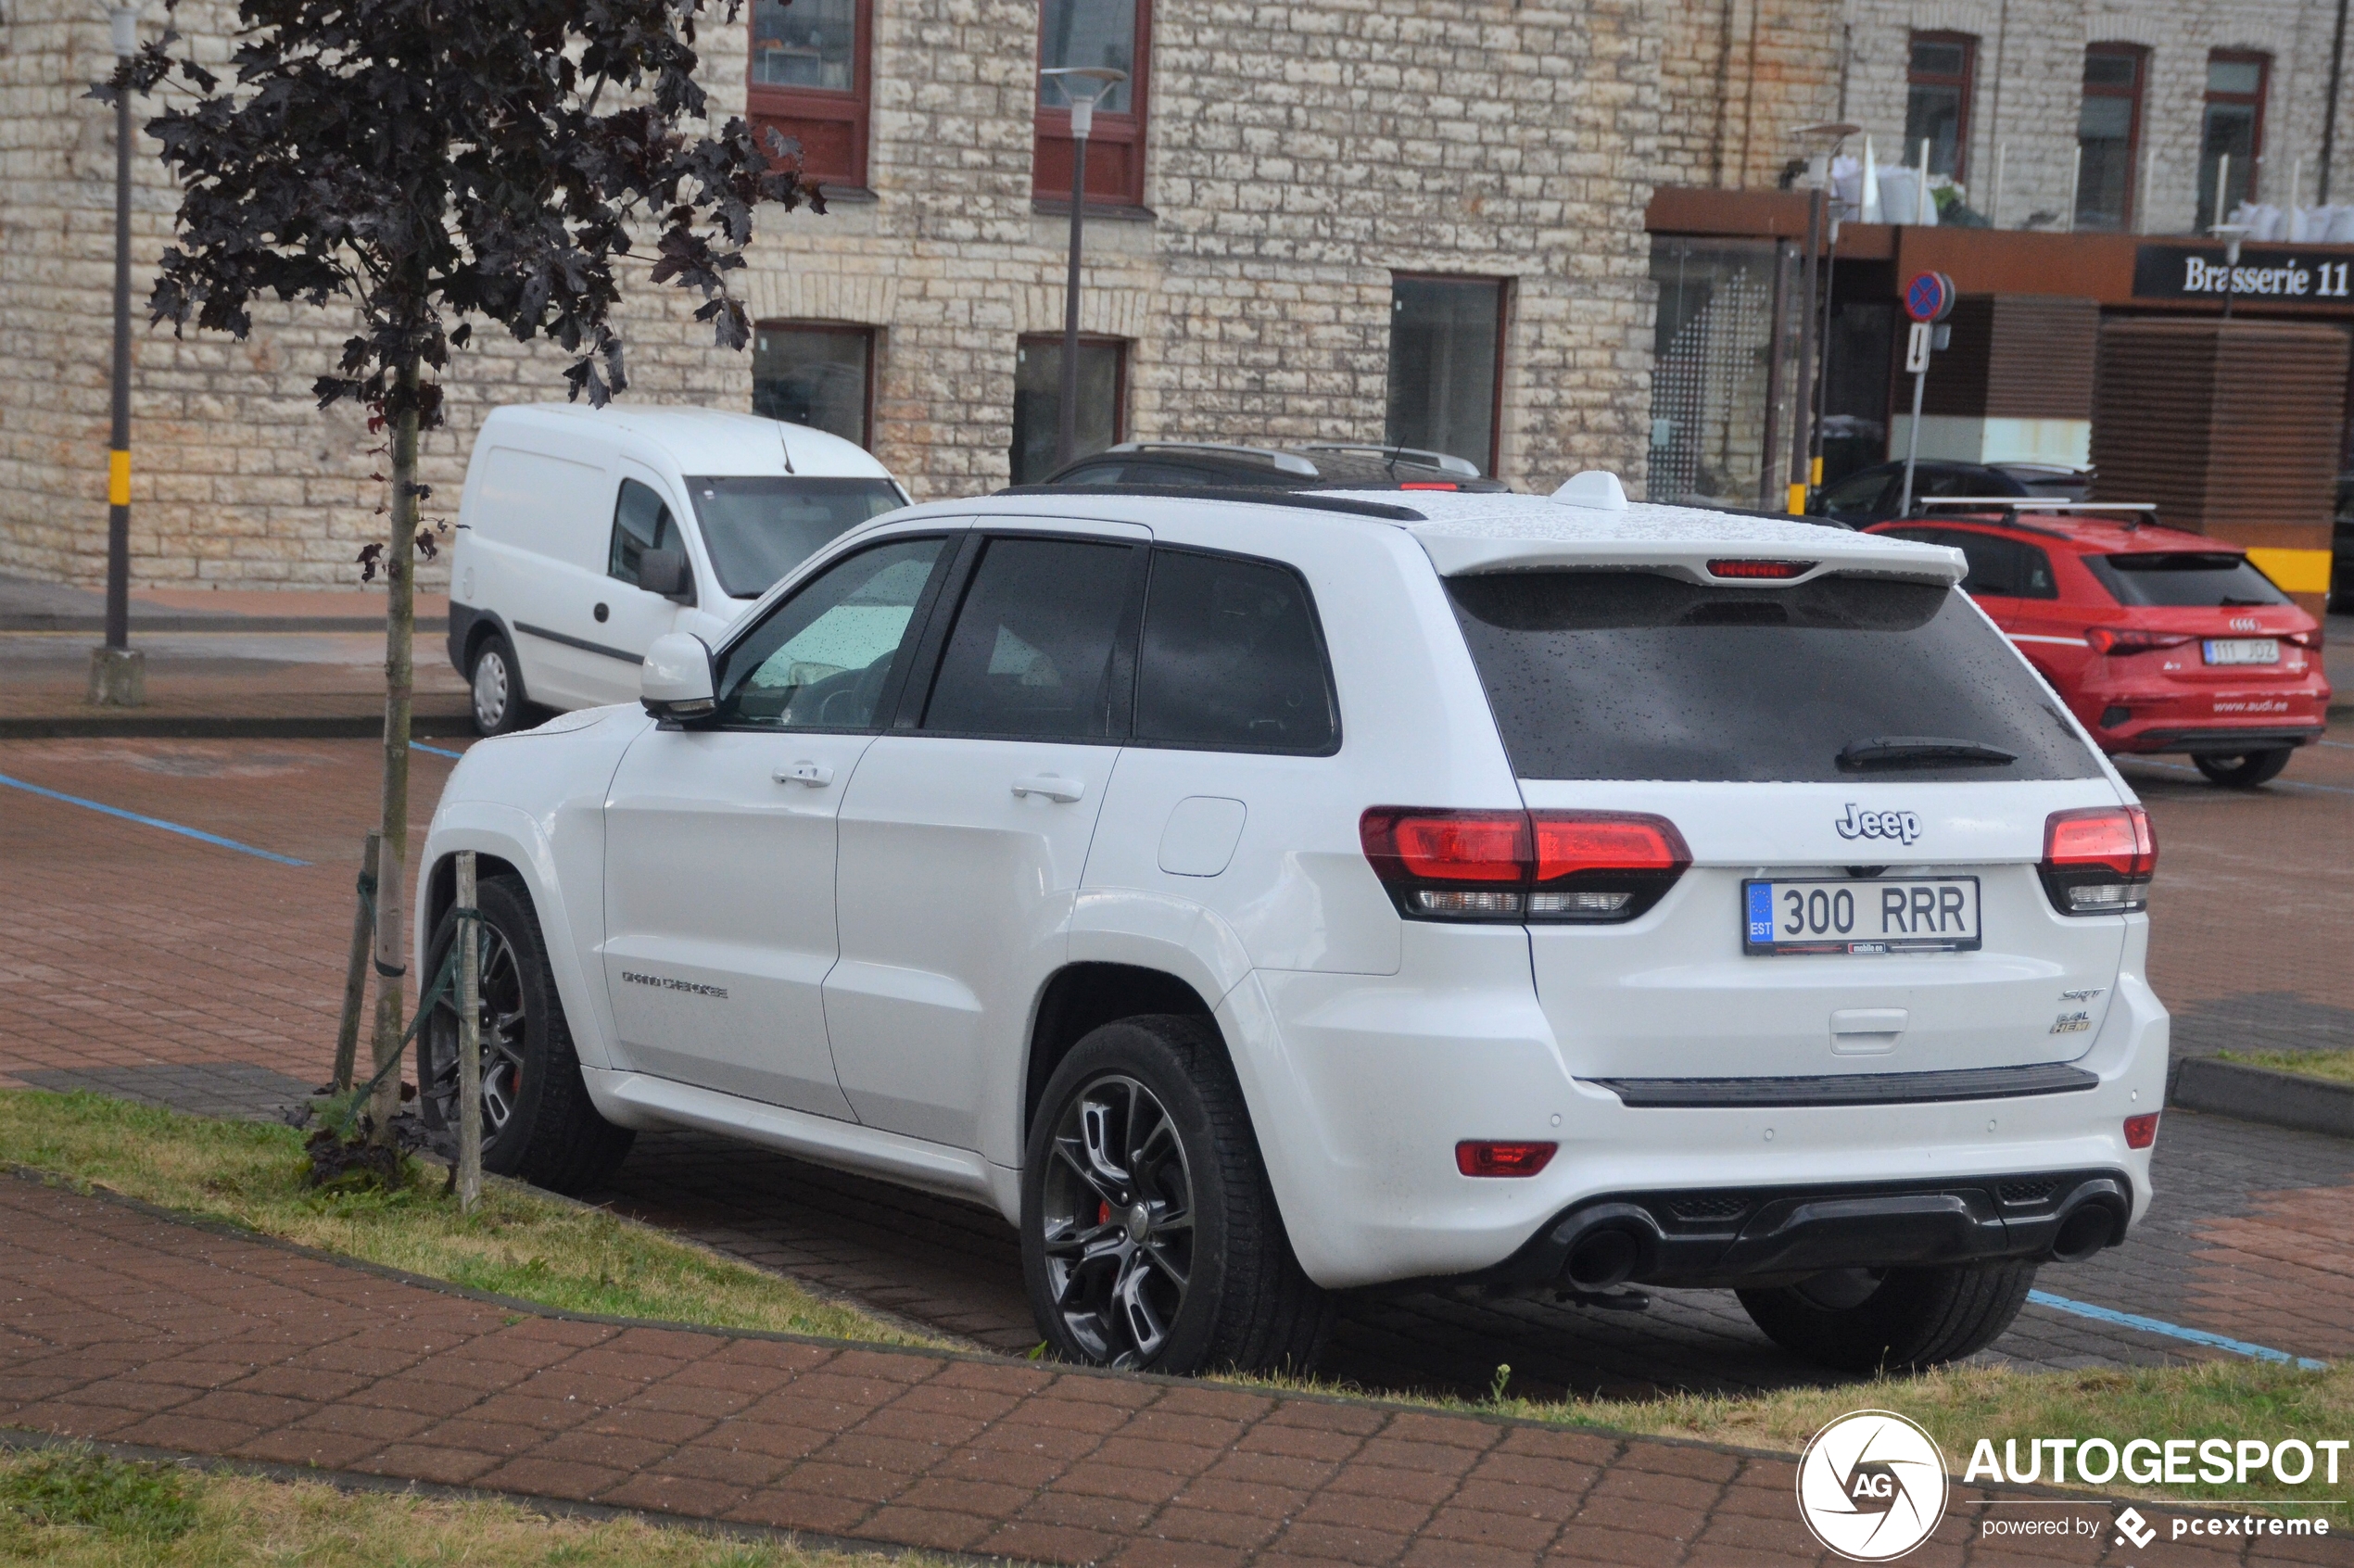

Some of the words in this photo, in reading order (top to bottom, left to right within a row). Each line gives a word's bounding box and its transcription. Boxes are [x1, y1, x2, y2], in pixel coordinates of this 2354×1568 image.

[2183, 256, 2310, 296] Brasserie
[2315, 261, 2350, 297] 11
[2215, 642, 2236, 659] 111
[2212, 699, 2289, 713] www.audi.ee
[1835, 803, 1922, 845] Jeep
[1783, 888, 1855, 935] 300
[1881, 886, 1966, 934] RRR
[1751, 922, 1772, 936] EST
[2057, 987, 2107, 1003] SRT
[2049, 1020, 2093, 1034] HEMI
